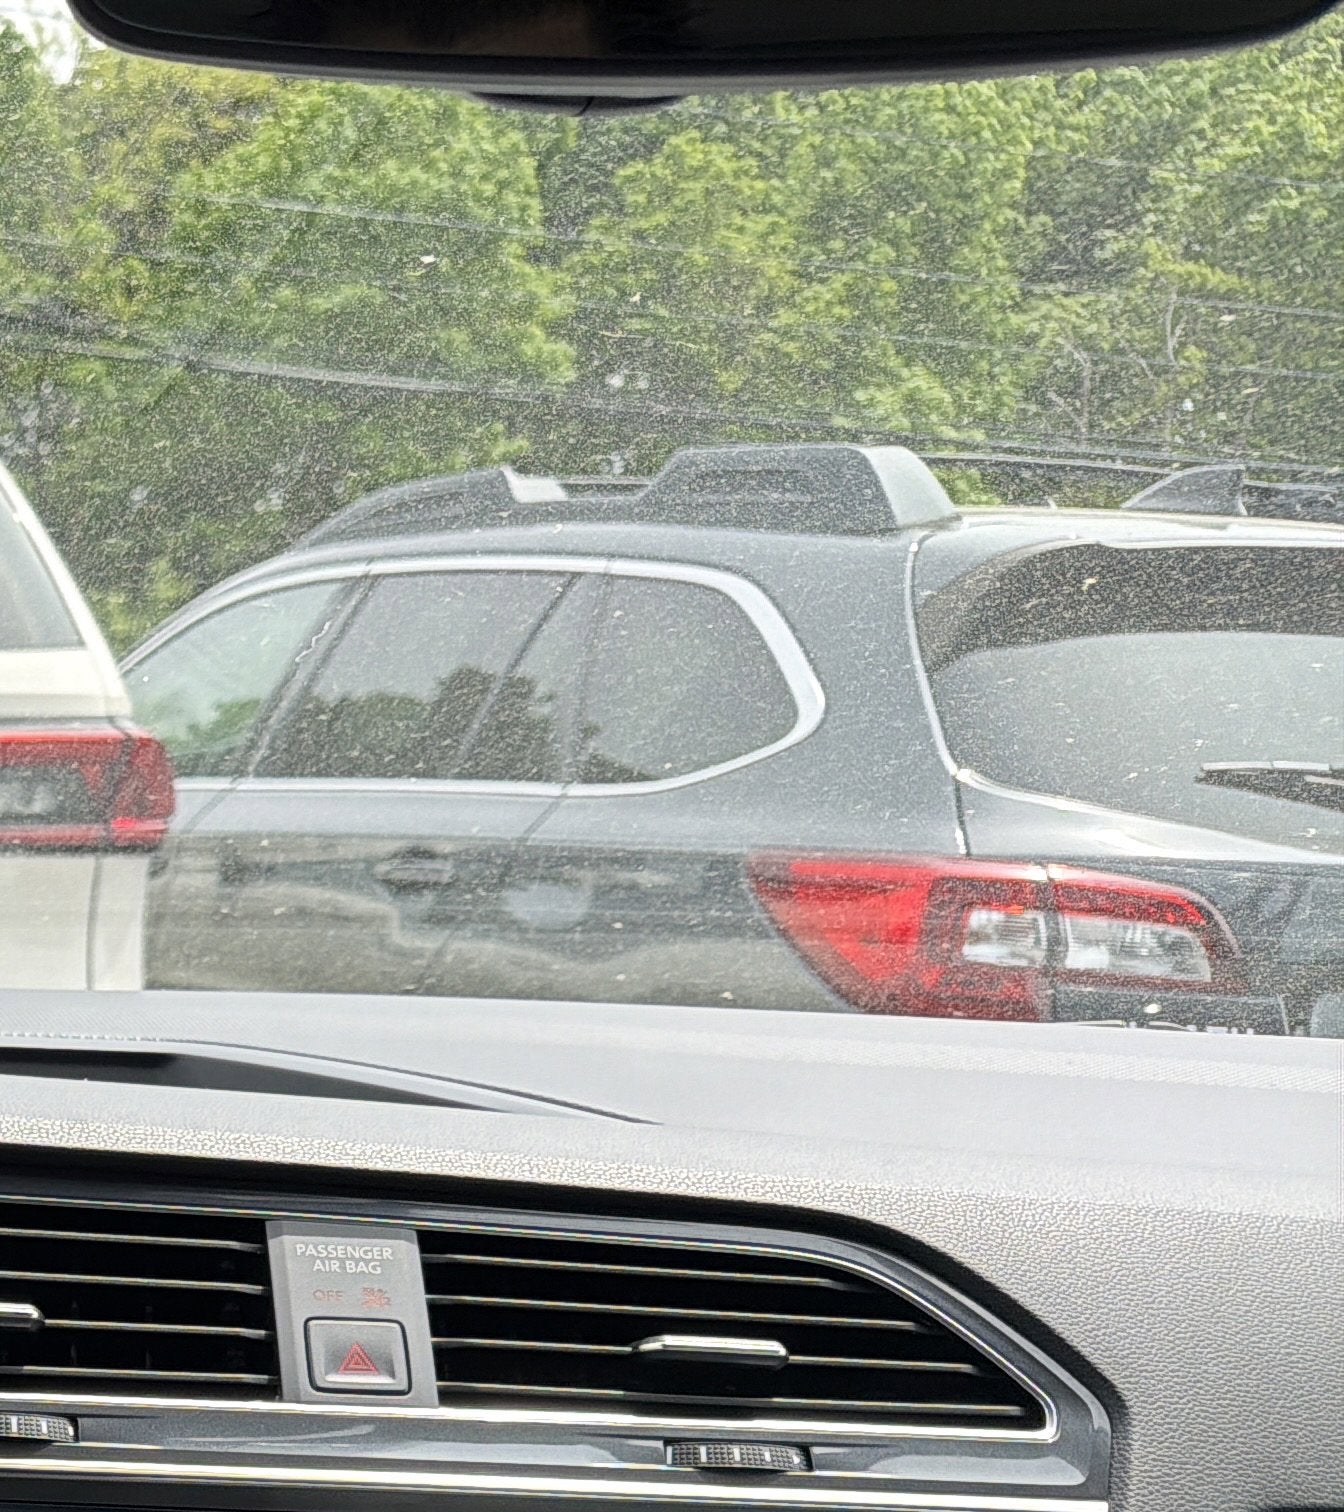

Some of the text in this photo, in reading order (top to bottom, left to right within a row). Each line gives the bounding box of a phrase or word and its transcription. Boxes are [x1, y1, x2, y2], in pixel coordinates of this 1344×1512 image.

[295, 1243, 394, 1261] PASSENGER
[312, 1259, 383, 1275] AIR BAG
